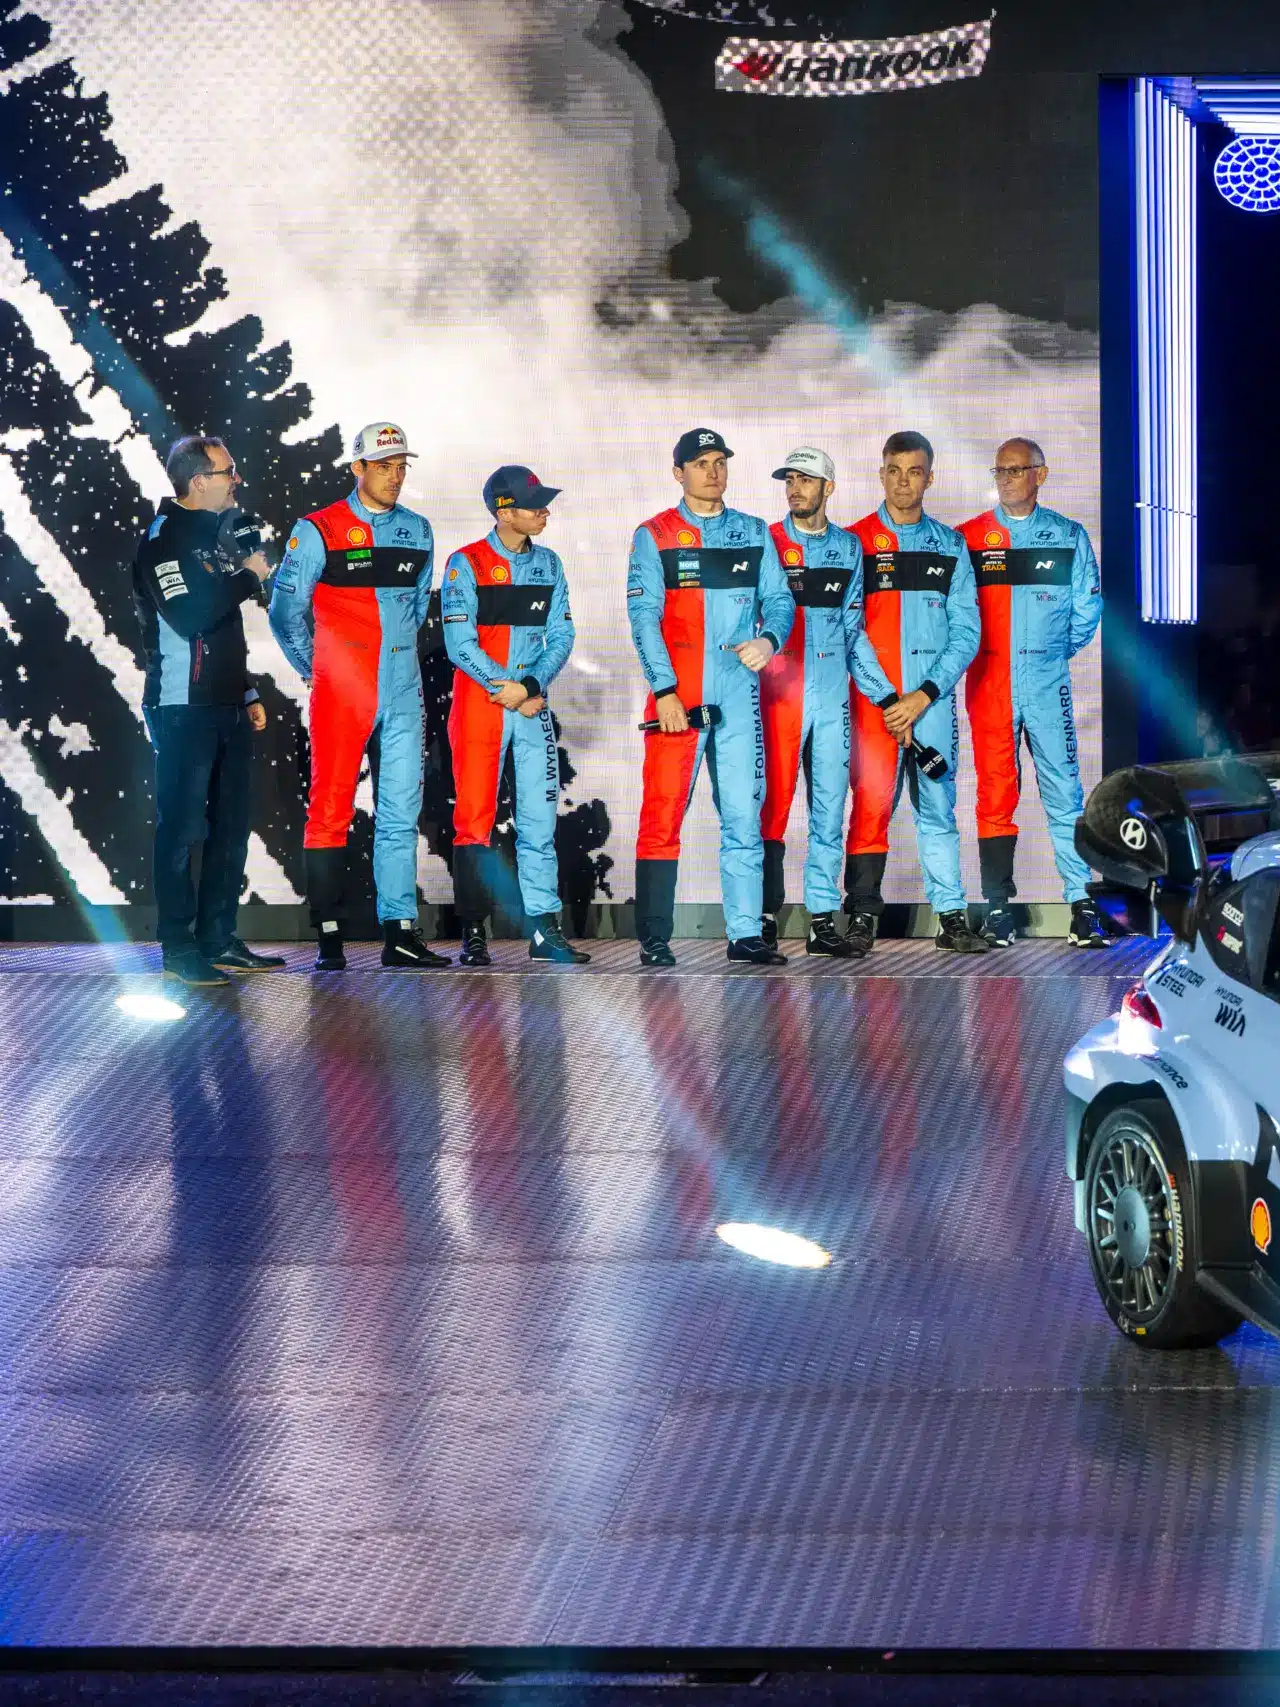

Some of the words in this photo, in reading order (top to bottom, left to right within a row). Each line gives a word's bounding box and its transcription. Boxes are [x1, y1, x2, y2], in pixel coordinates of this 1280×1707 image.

[377, 437, 391, 447] Red
[1036, 594, 1058, 602] MOBIS
[857, 661, 886, 692] HYUNDAI
[750, 684, 765, 780] FOURMAUX
[1058, 685, 1076, 765] KENNARD
[546, 785, 557, 802] M.
[753, 785, 762, 801] A.
[1160, 975, 1187, 998] STEEL
[1170, 964, 1207, 989] HYUNDAI
[1213, 985, 1245, 1007] HYUNDAI
